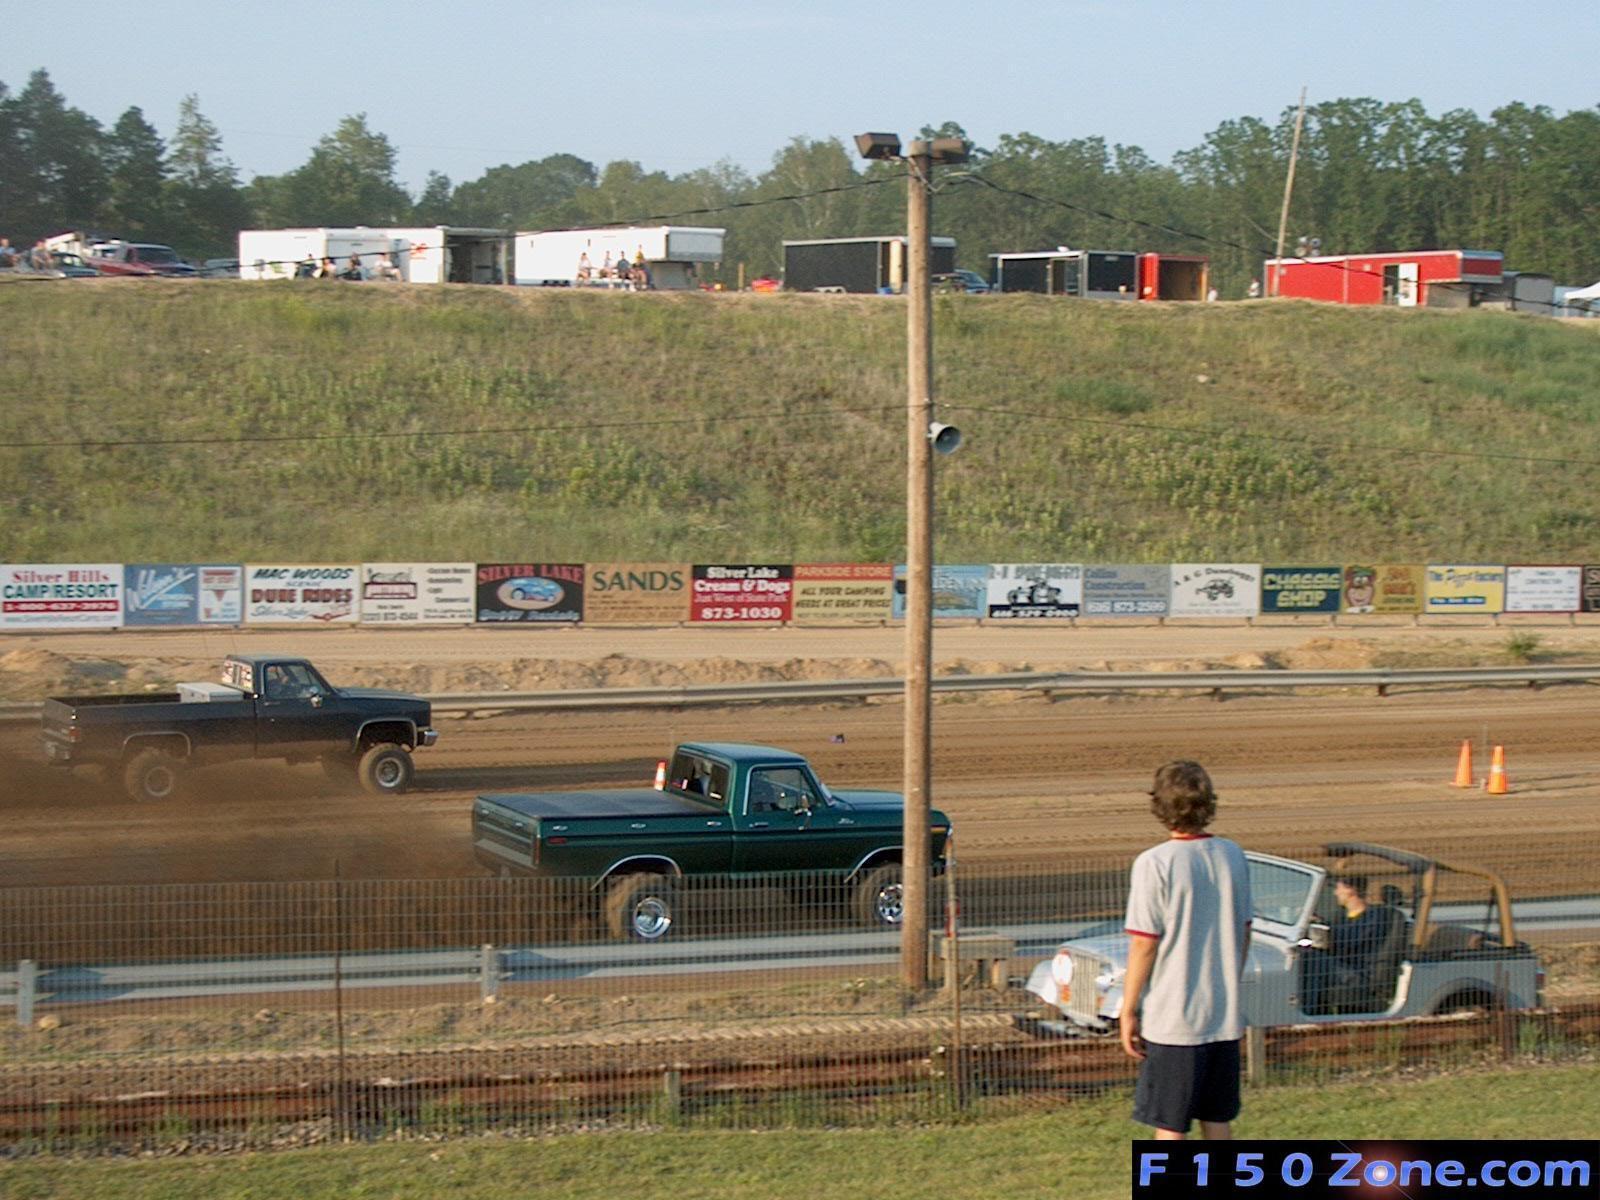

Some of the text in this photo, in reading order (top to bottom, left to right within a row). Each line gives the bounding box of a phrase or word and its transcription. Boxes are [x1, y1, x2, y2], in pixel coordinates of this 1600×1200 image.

[12, 570, 109, 583] Silver Hills
[253, 568, 354, 579] MAC WOODS
[479, 564, 583, 585] SILVER LAKE
[707, 566, 779, 579] Silver Lake
[795, 566, 892, 577] PARKSIDE STORE
[592, 571, 684, 591] SANDS
[694, 579, 791, 594] Cream & Dogs
[1263, 573, 1340, 590] CHASSIS
[3, 584, 118, 598] CAMP RESORT
[251, 588, 353, 603] DUNE RIDES
[801, 587, 816, 595] ALL
[819, 587, 842, 595] YOUR
[1277, 590, 1327, 608] SHOP
[702, 607, 782, 619] 873-1030
